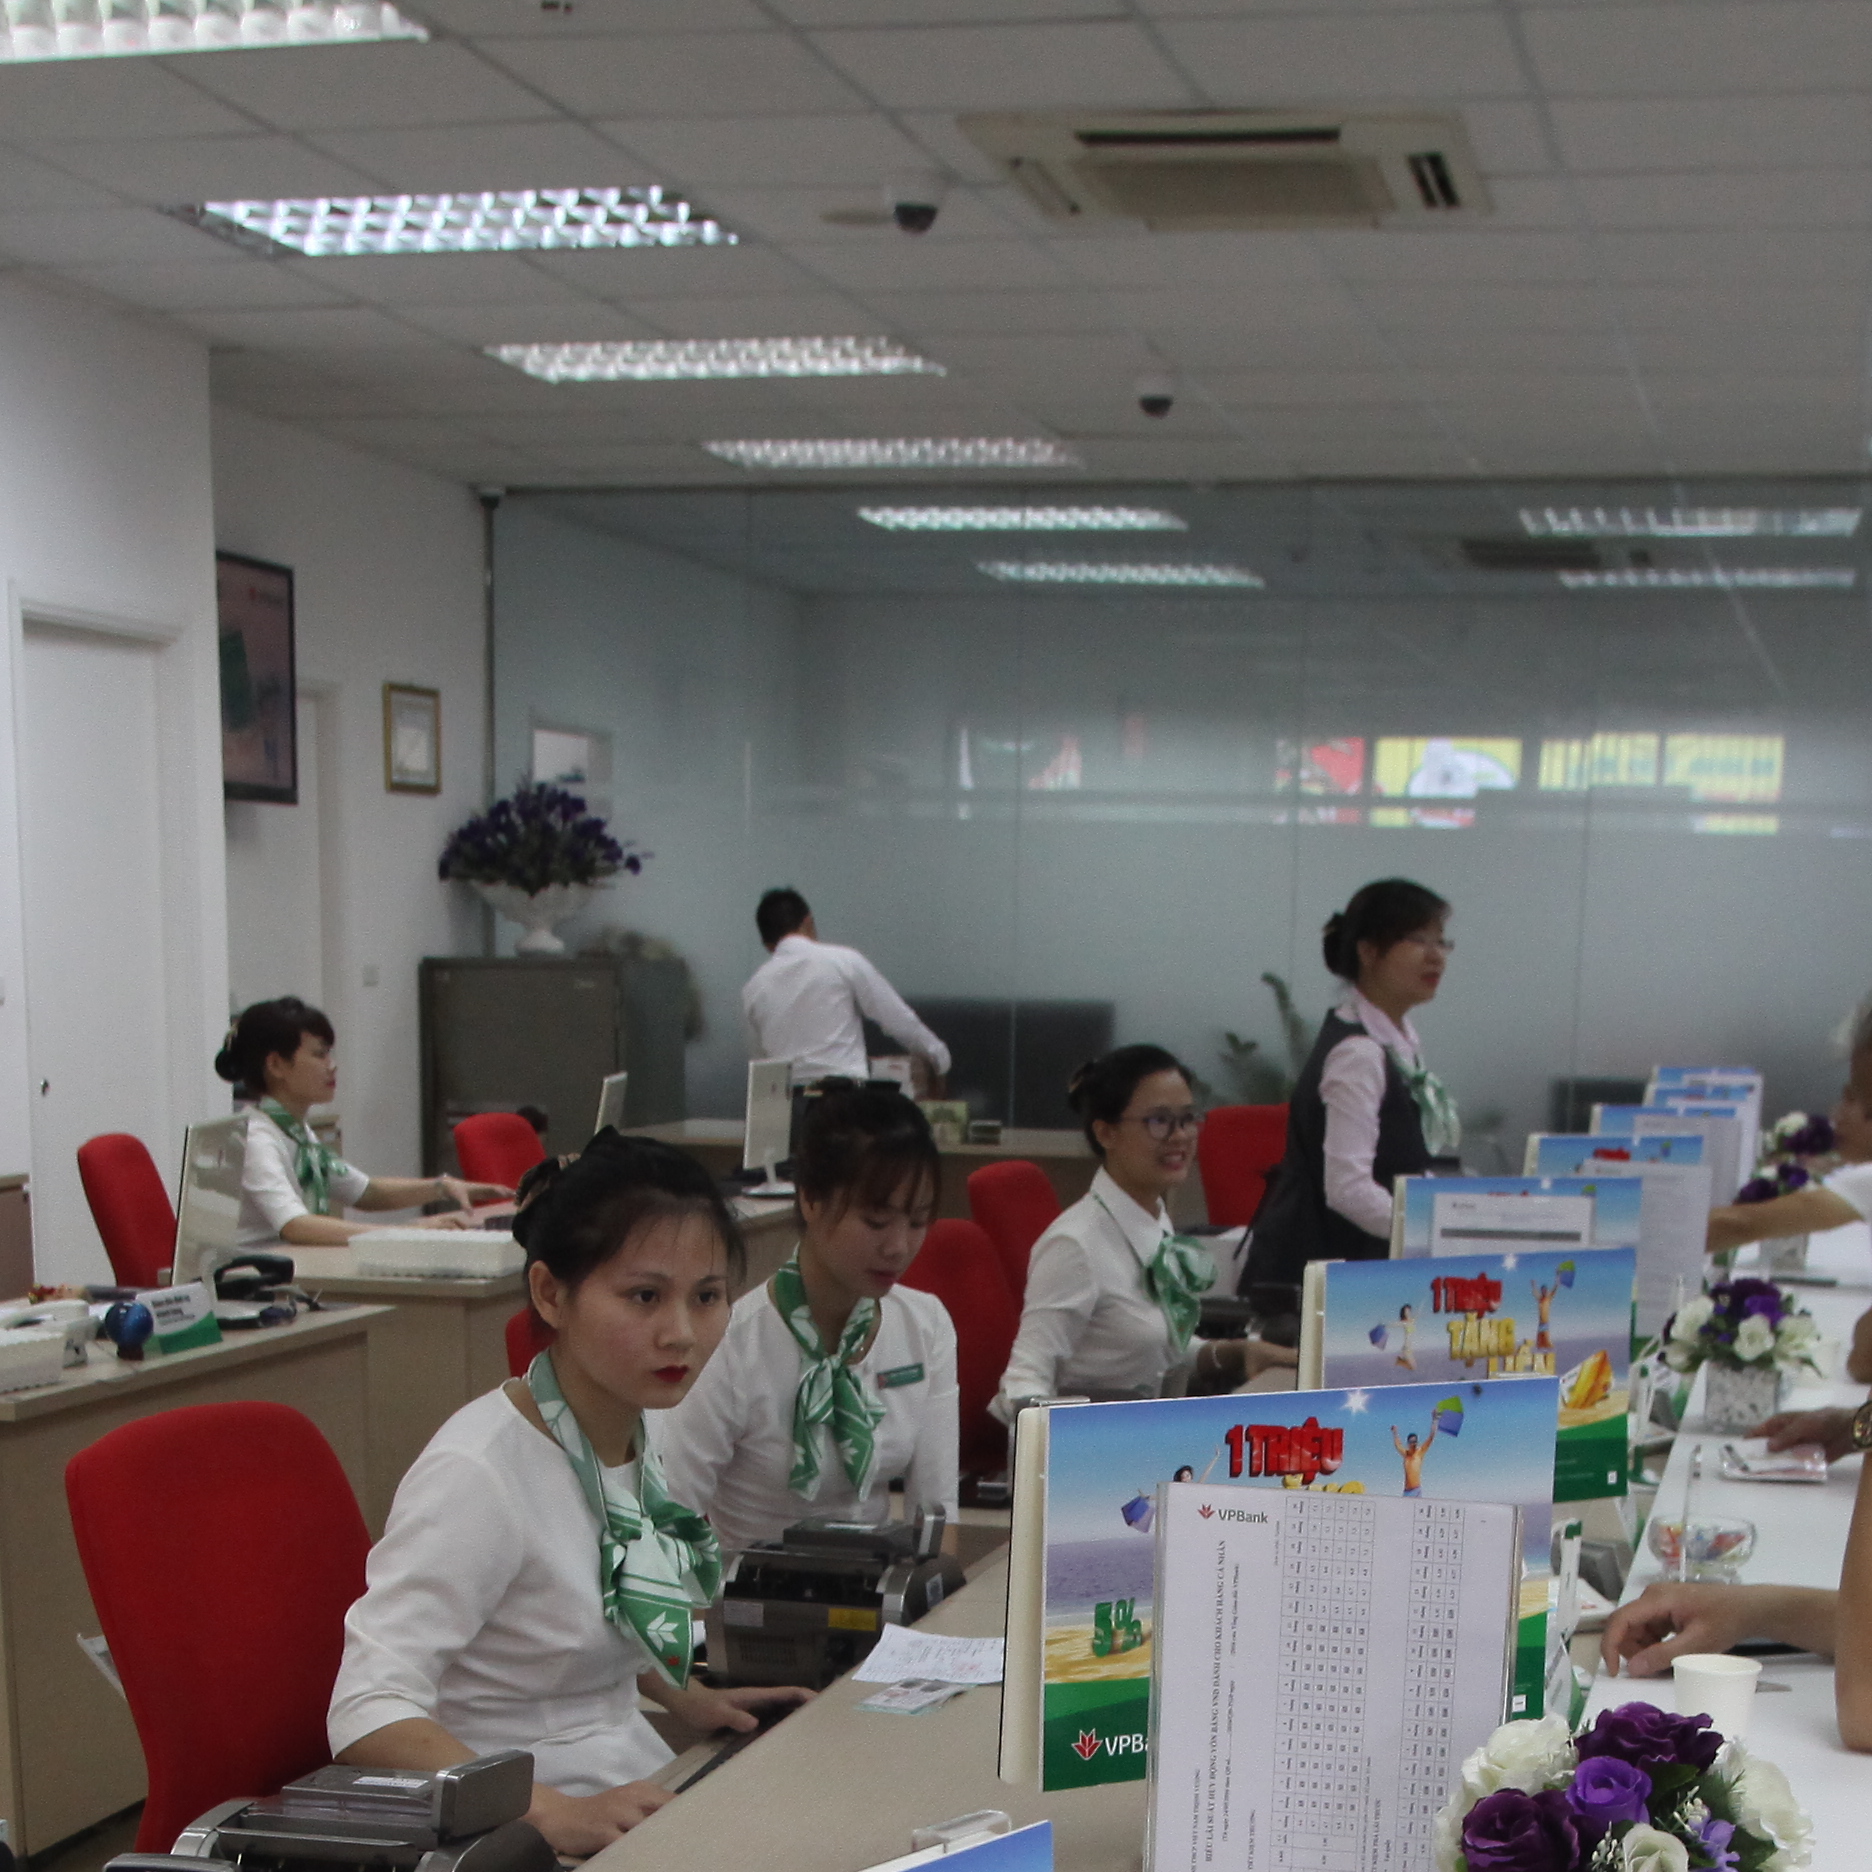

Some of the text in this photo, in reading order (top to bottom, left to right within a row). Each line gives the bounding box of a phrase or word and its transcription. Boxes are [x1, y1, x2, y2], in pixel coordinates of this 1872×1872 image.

[1225, 1416, 1344, 1485] 1 TRIỆU
[1218, 1508, 1268, 1525] VPBank
[1092, 1597, 1142, 1657] 5%
[1105, 1732, 1148, 1756] VPB
